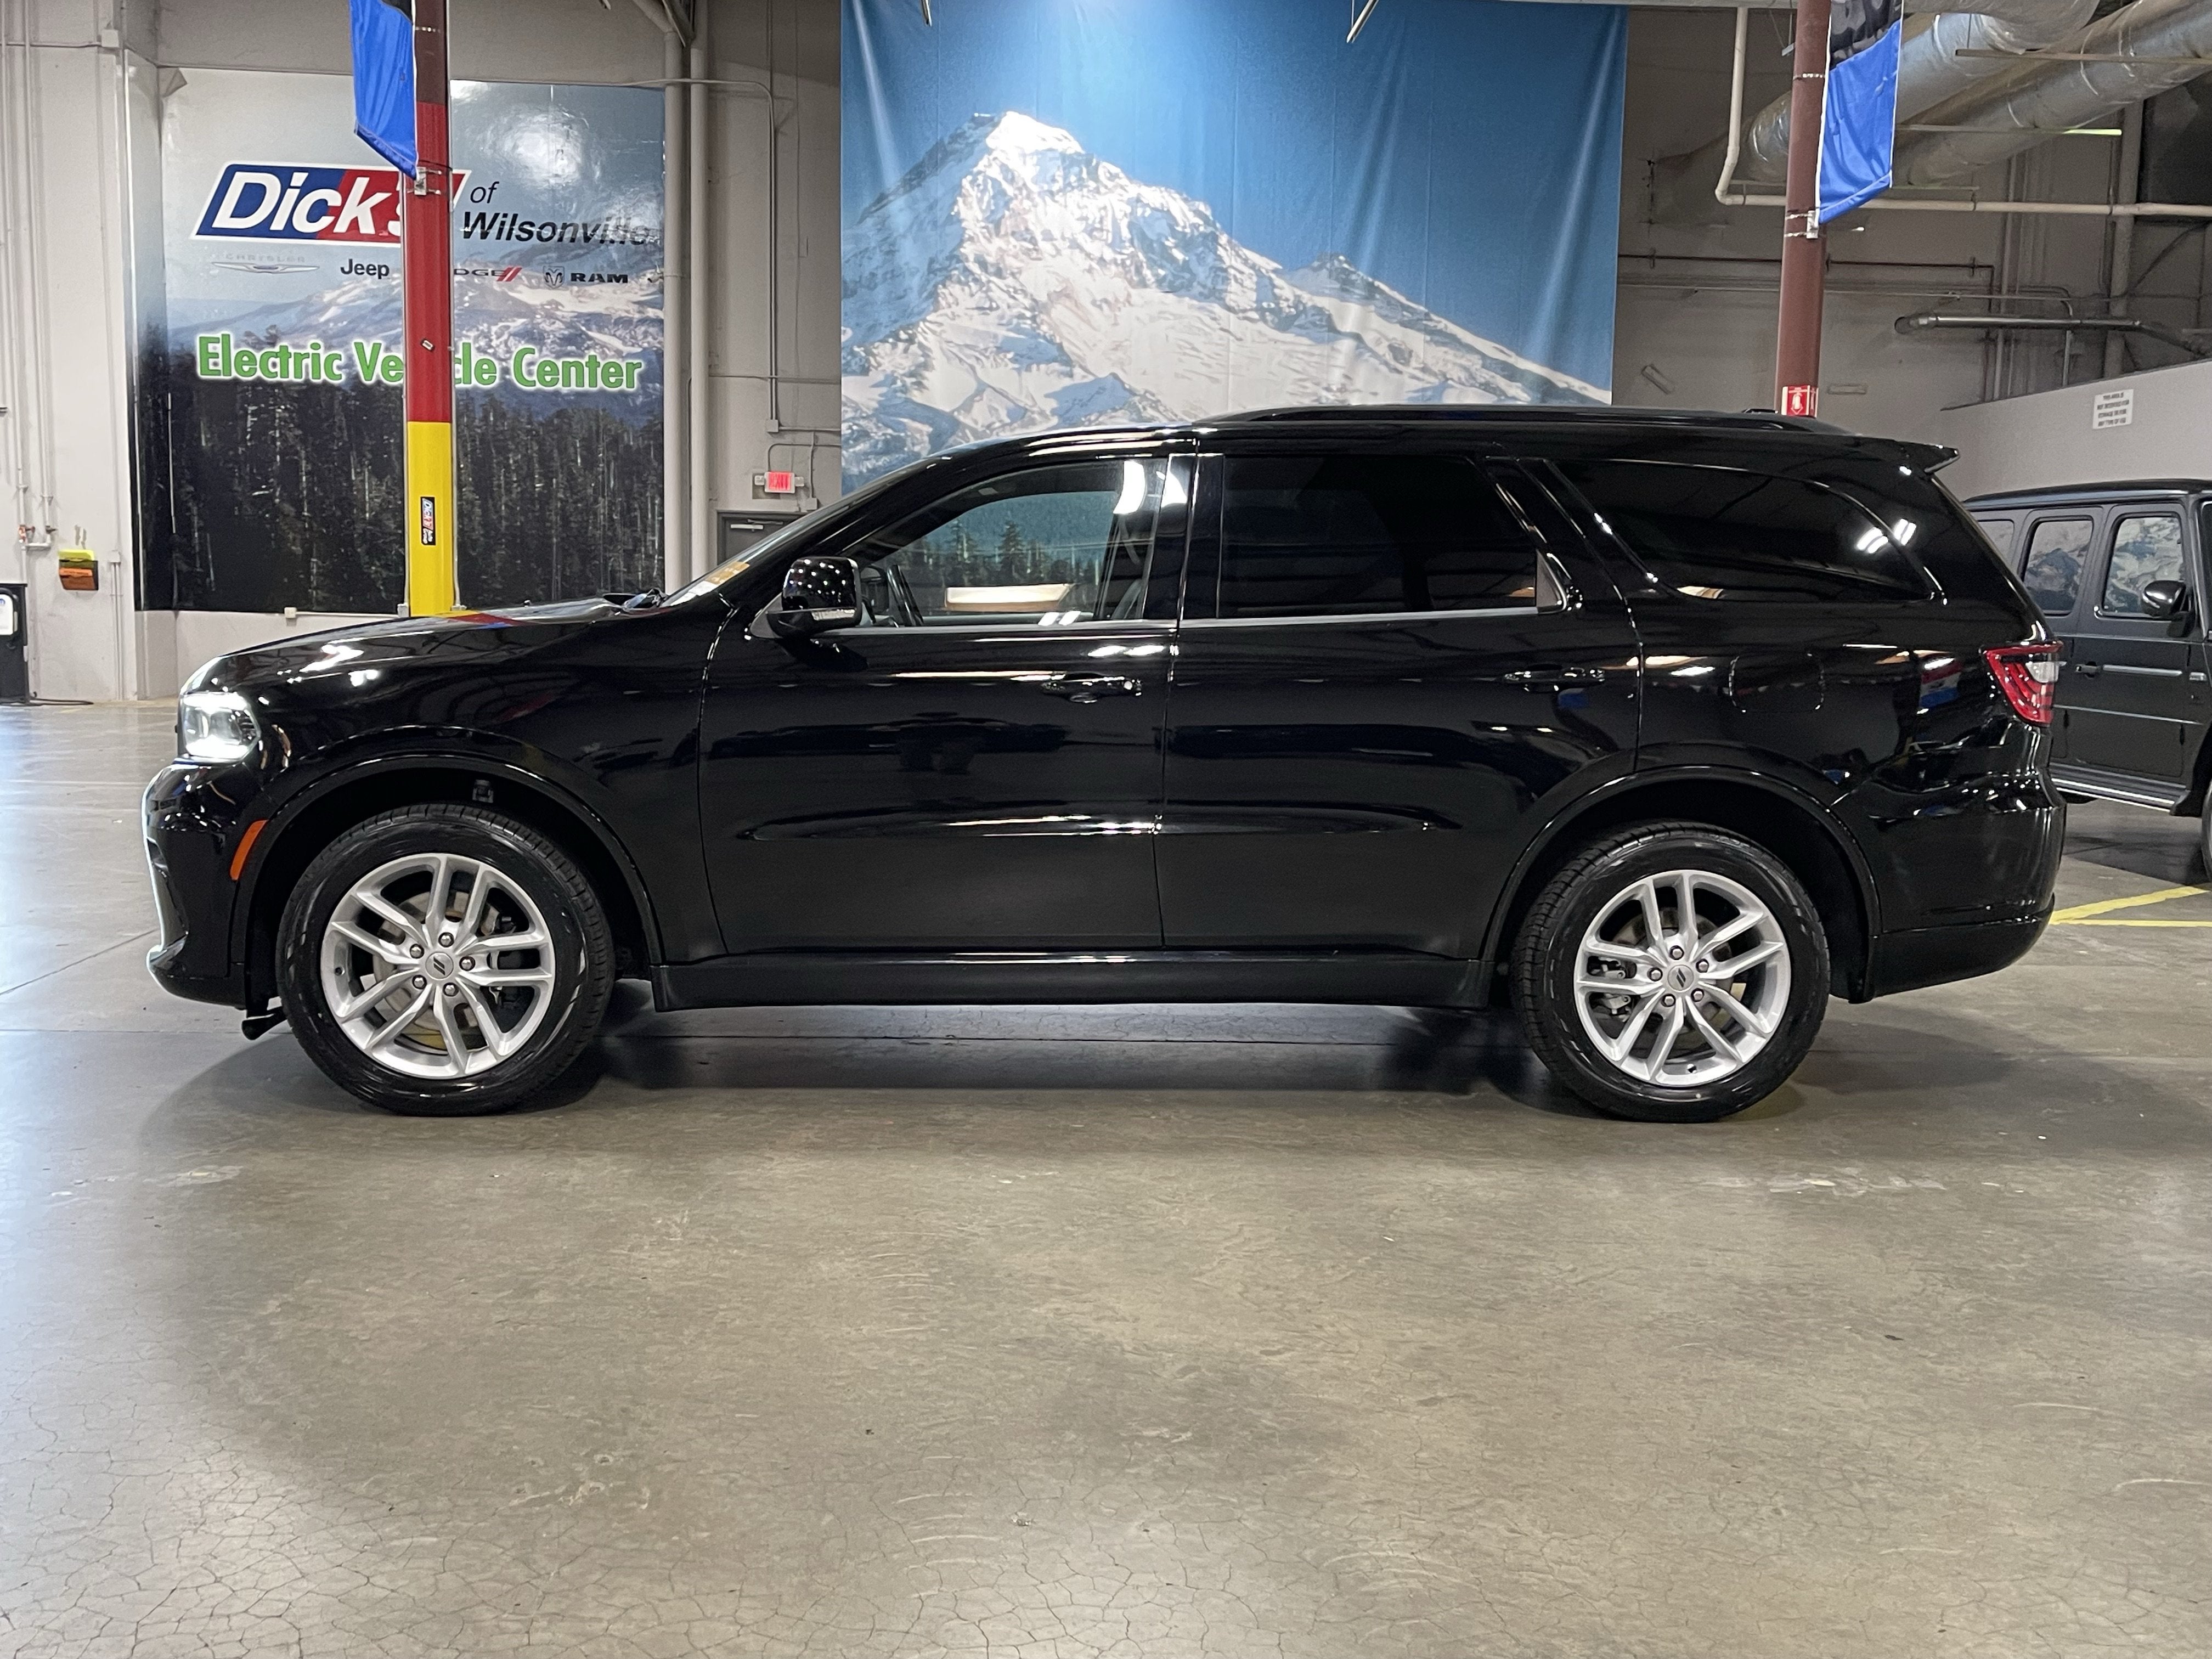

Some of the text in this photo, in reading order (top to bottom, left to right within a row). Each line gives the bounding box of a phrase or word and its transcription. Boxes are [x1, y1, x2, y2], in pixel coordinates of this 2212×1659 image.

[212, 171, 401, 236] Dick
[470, 181, 500, 204] of
[340, 258, 390, 279] Jeep
[453, 268, 507, 277] DGE
[570, 273, 629, 284] RAM
[198, 333, 642, 388] Electric Vele Center
